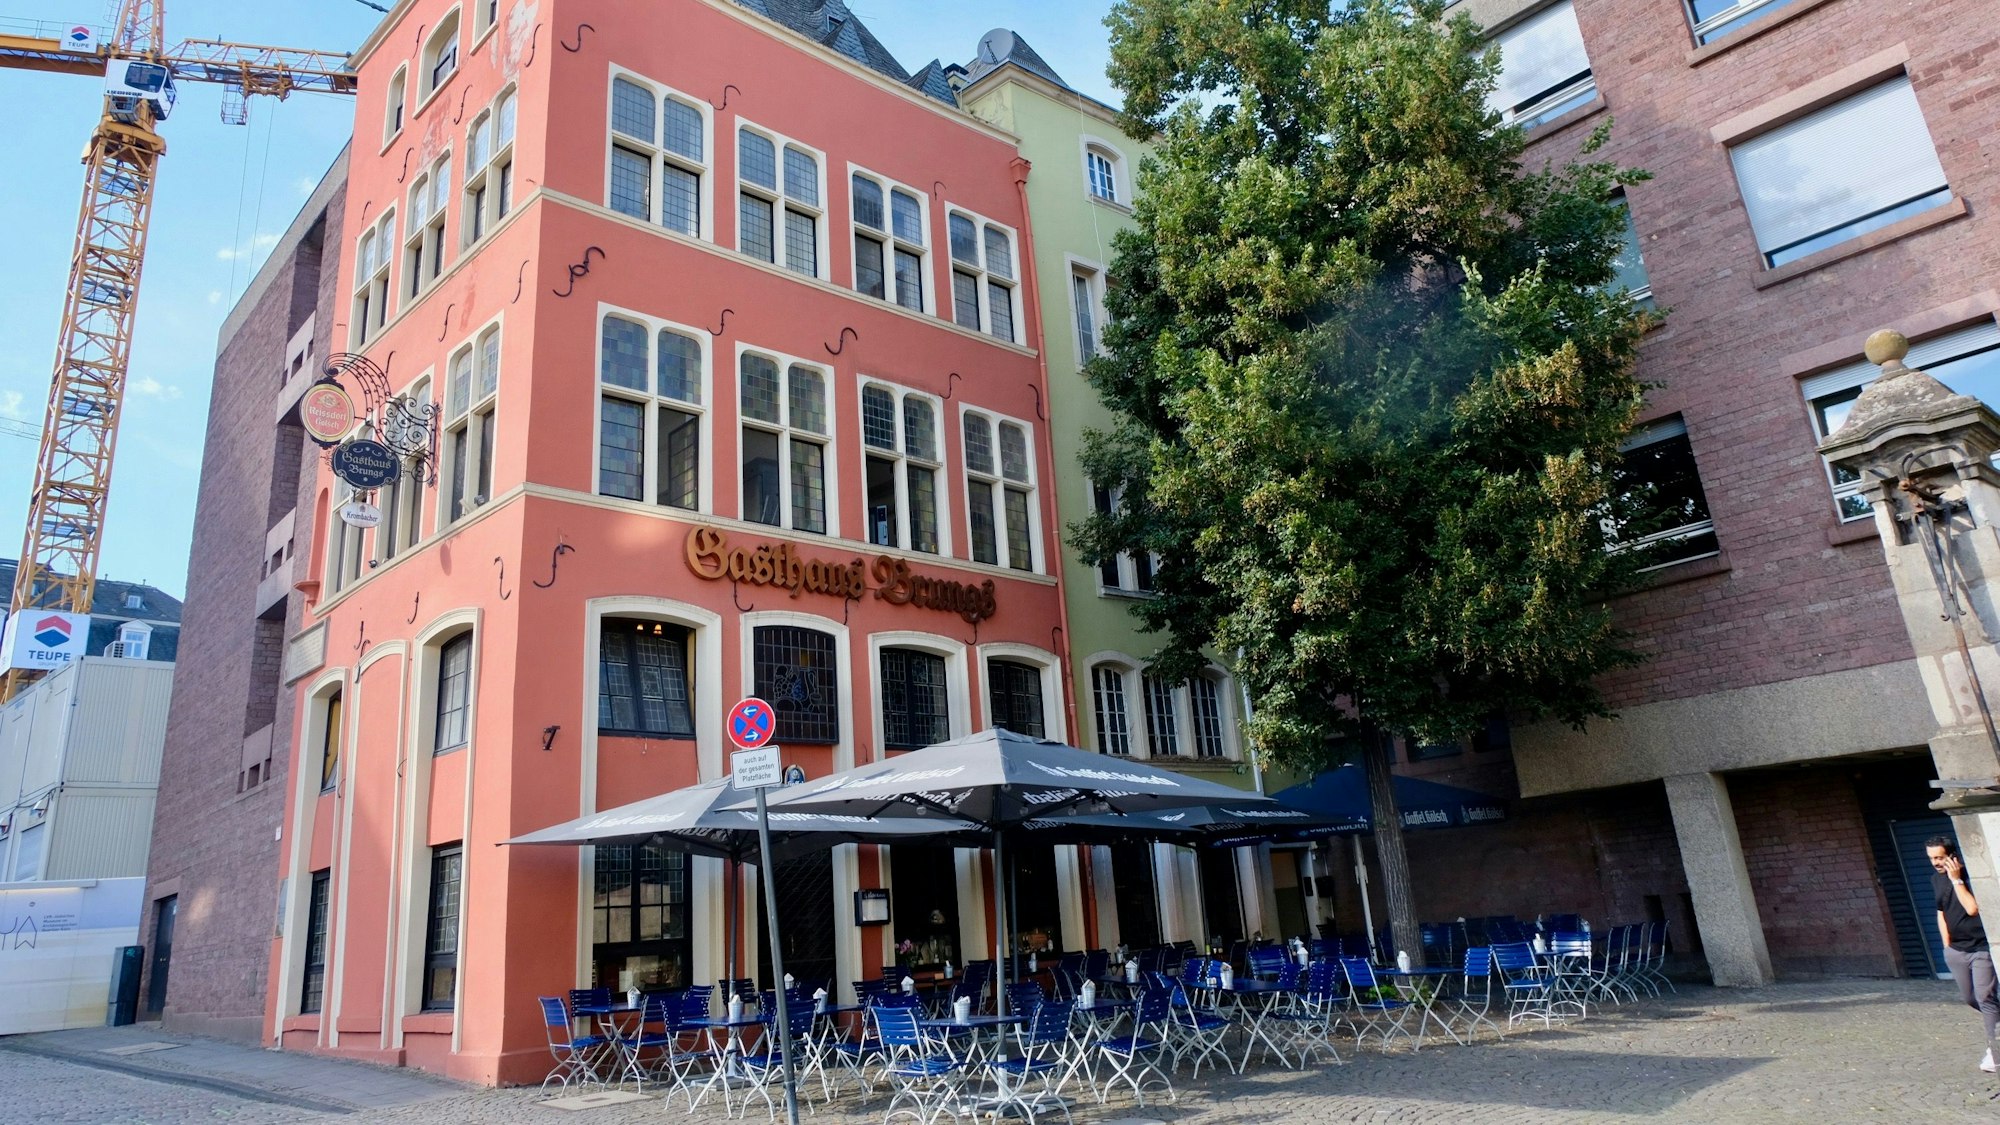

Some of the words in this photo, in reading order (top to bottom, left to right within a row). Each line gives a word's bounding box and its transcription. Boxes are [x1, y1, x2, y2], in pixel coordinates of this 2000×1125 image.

[68, 41, 90, 49] TEUPE
[342, 452, 392, 469] Gasthaus
[348, 464, 384, 478] Brungs
[346, 511, 379, 523] Krombacher
[684, 524, 867, 600] Gasthaus
[871, 553, 997, 624] Brungs
[28, 650, 71, 661] TEUPE
[743, 755, 757, 764] auch
[758, 754, 767, 762] auf
[738, 766, 748, 774] der
[748, 763, 775, 774] gesamten
[742, 773, 772, 783] Platzfläche
[1404, 810, 1427, 825] Gaffel
